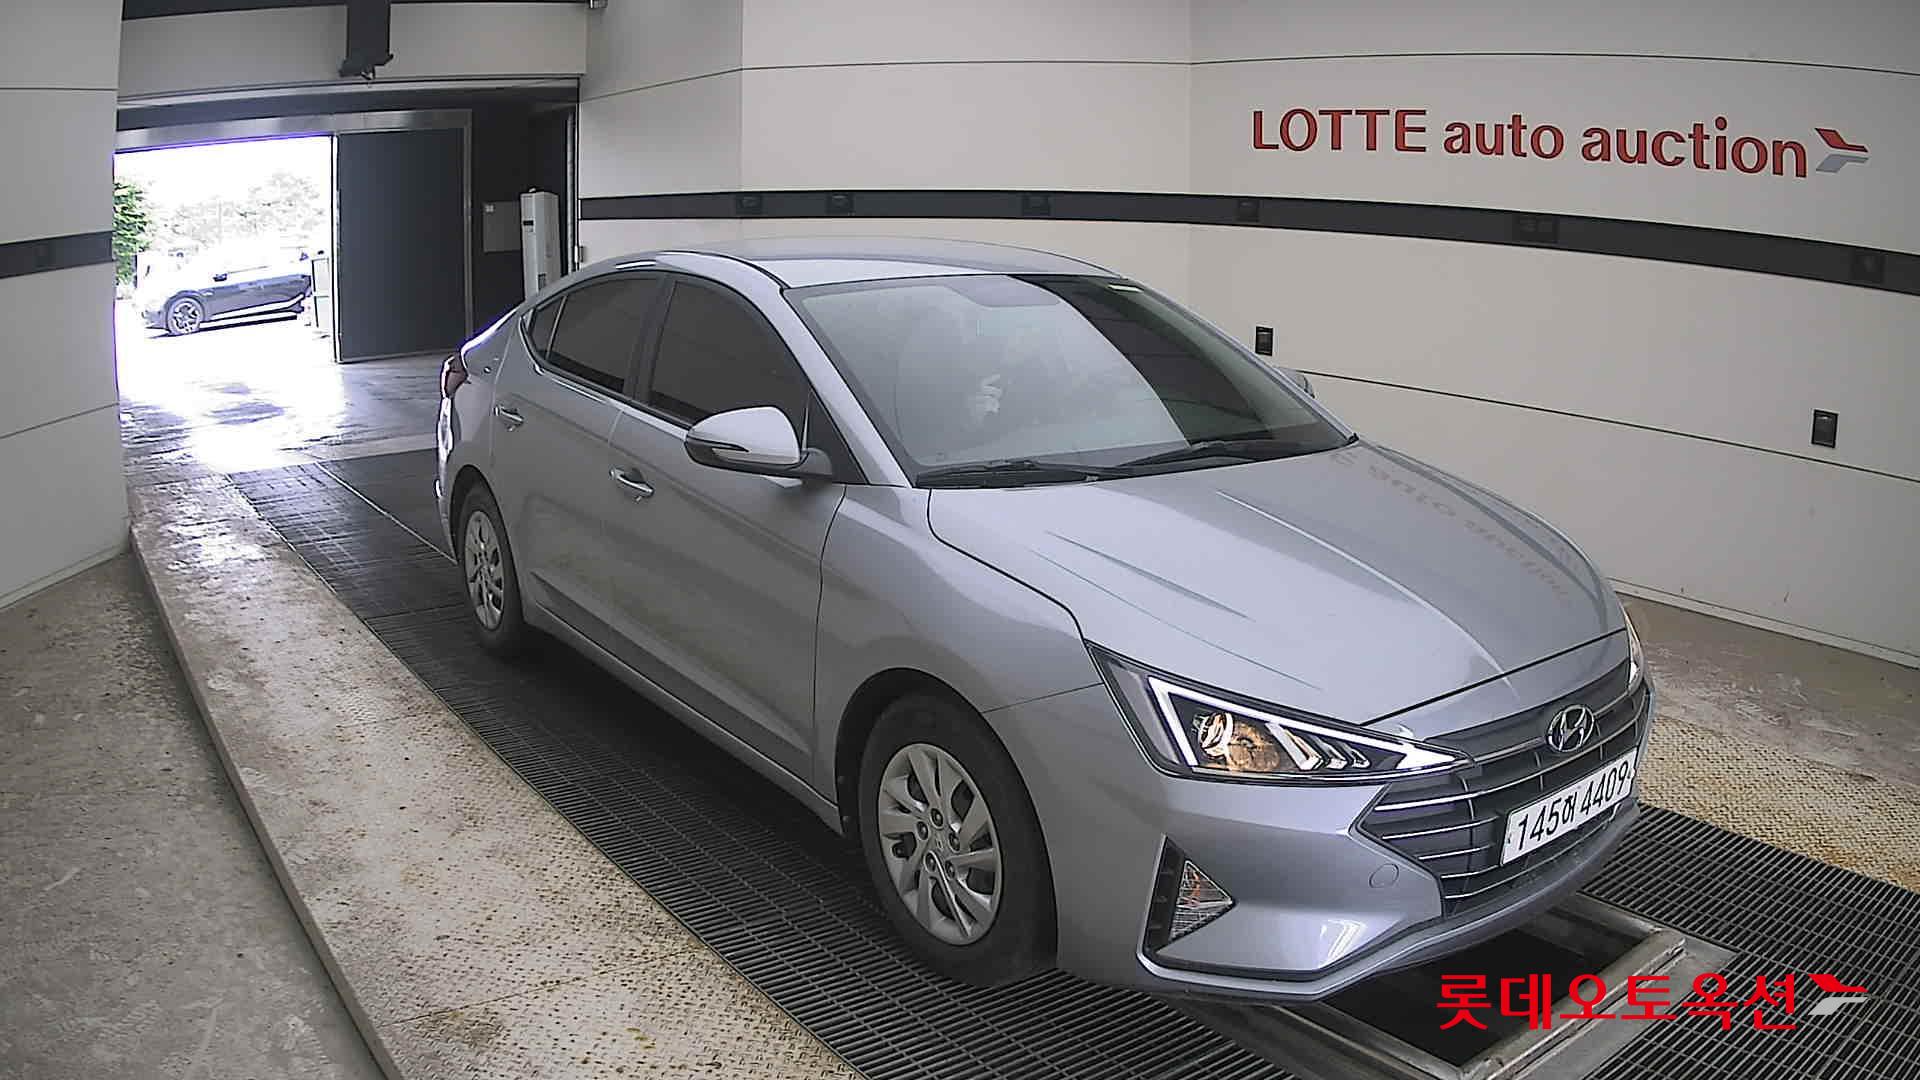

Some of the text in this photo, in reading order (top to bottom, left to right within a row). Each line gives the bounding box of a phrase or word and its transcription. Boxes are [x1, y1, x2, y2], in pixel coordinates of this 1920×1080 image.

[1252, 108, 1808, 178] LOTTE auto auction
[1581, 760, 1629, 816] 4409
